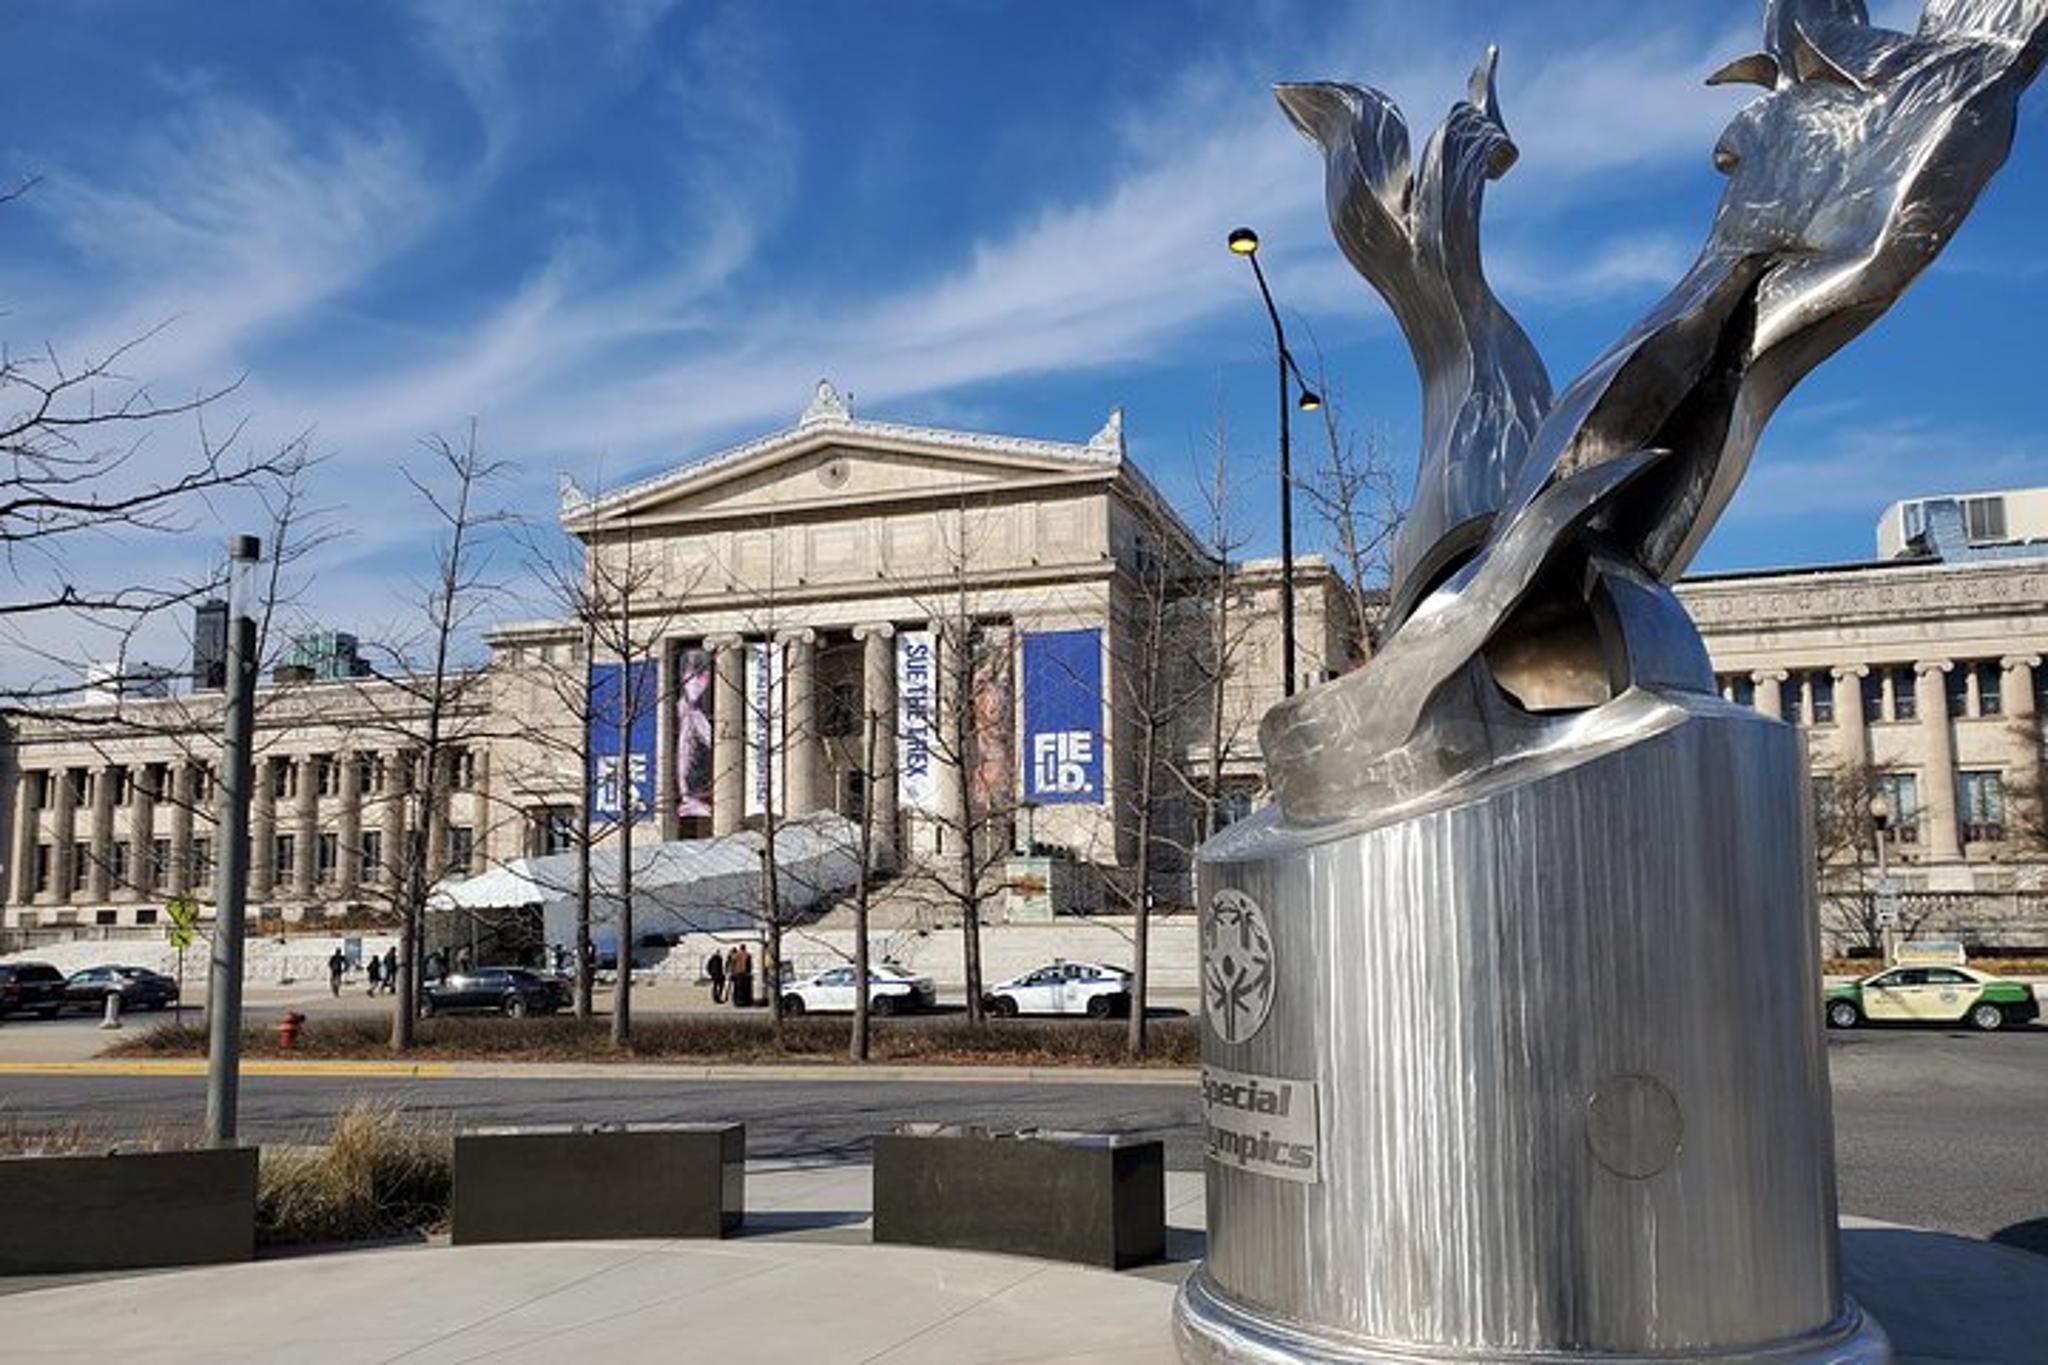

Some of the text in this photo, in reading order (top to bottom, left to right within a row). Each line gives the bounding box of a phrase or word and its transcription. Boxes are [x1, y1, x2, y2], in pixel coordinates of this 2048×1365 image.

[907, 644, 928, 682] SUE
[907, 683, 928, 719] THE
[1034, 731, 1093, 763] FIE
[597, 754, 647, 783] FE
